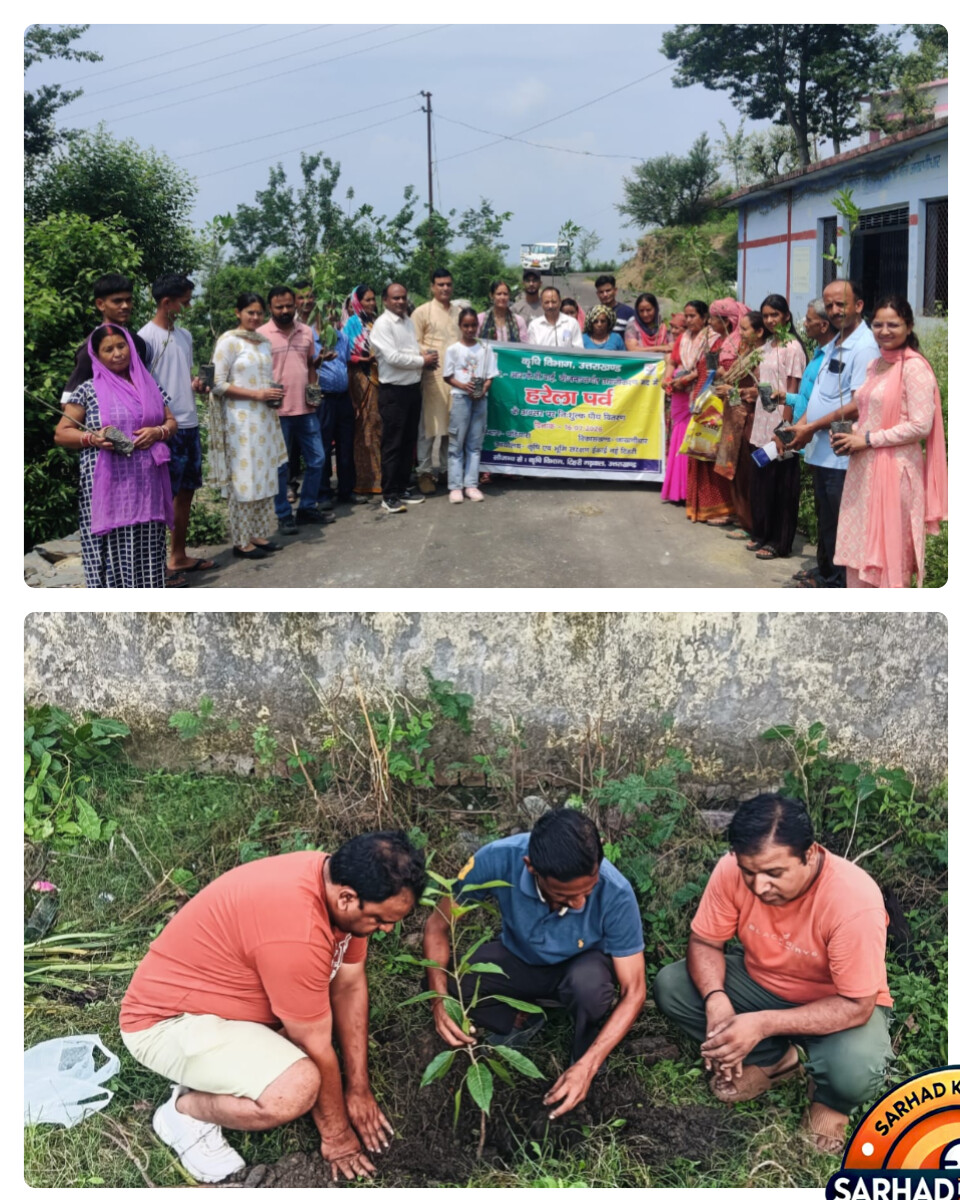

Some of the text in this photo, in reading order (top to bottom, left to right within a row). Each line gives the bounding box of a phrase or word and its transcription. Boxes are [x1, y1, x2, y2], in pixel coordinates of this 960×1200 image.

[521, 355, 622, 372] कृषि विभाग, उत्तराखण्ड
[524, 384, 614, 406] हरेला पर्व
